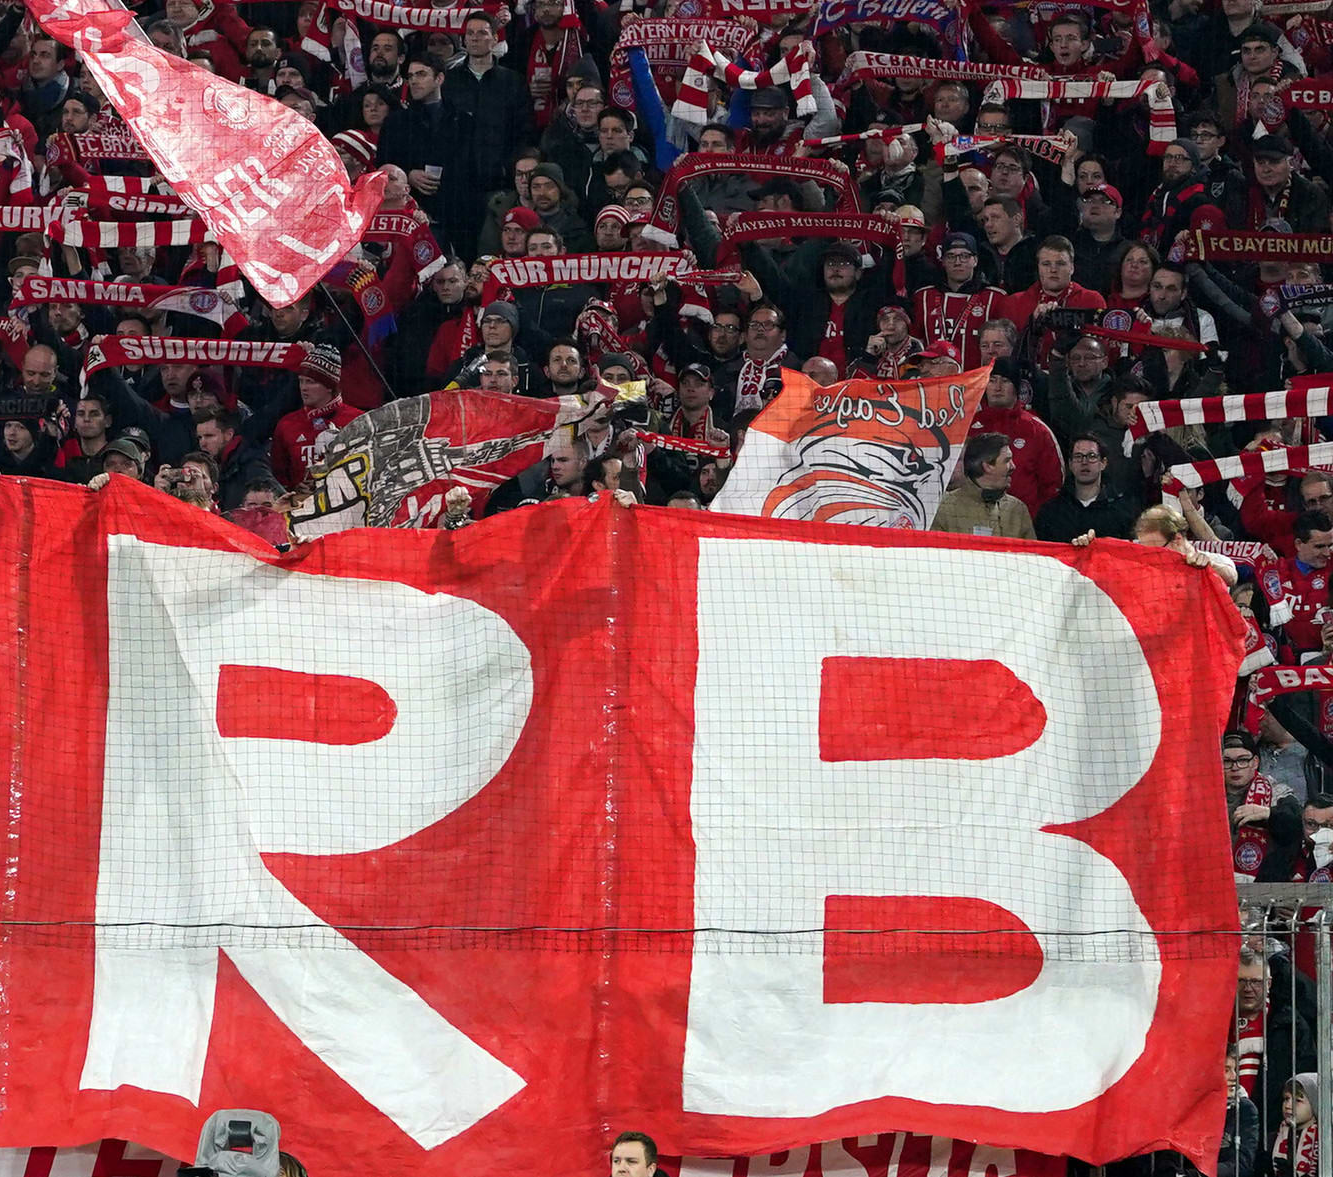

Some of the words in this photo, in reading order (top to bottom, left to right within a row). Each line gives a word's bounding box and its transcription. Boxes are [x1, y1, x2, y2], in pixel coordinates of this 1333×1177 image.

[866, 53, 884, 66] FC
[1211, 235, 1230, 248] FC
[1234, 235, 1301, 251] BAYERN
[492, 256, 551, 287] FÜR
[30, 280, 89, 300] SAN
[94, 283, 145, 302] MIA
[125, 338, 287, 364] SÜDKURVE
[80, 534, 1162, 1150] RB
